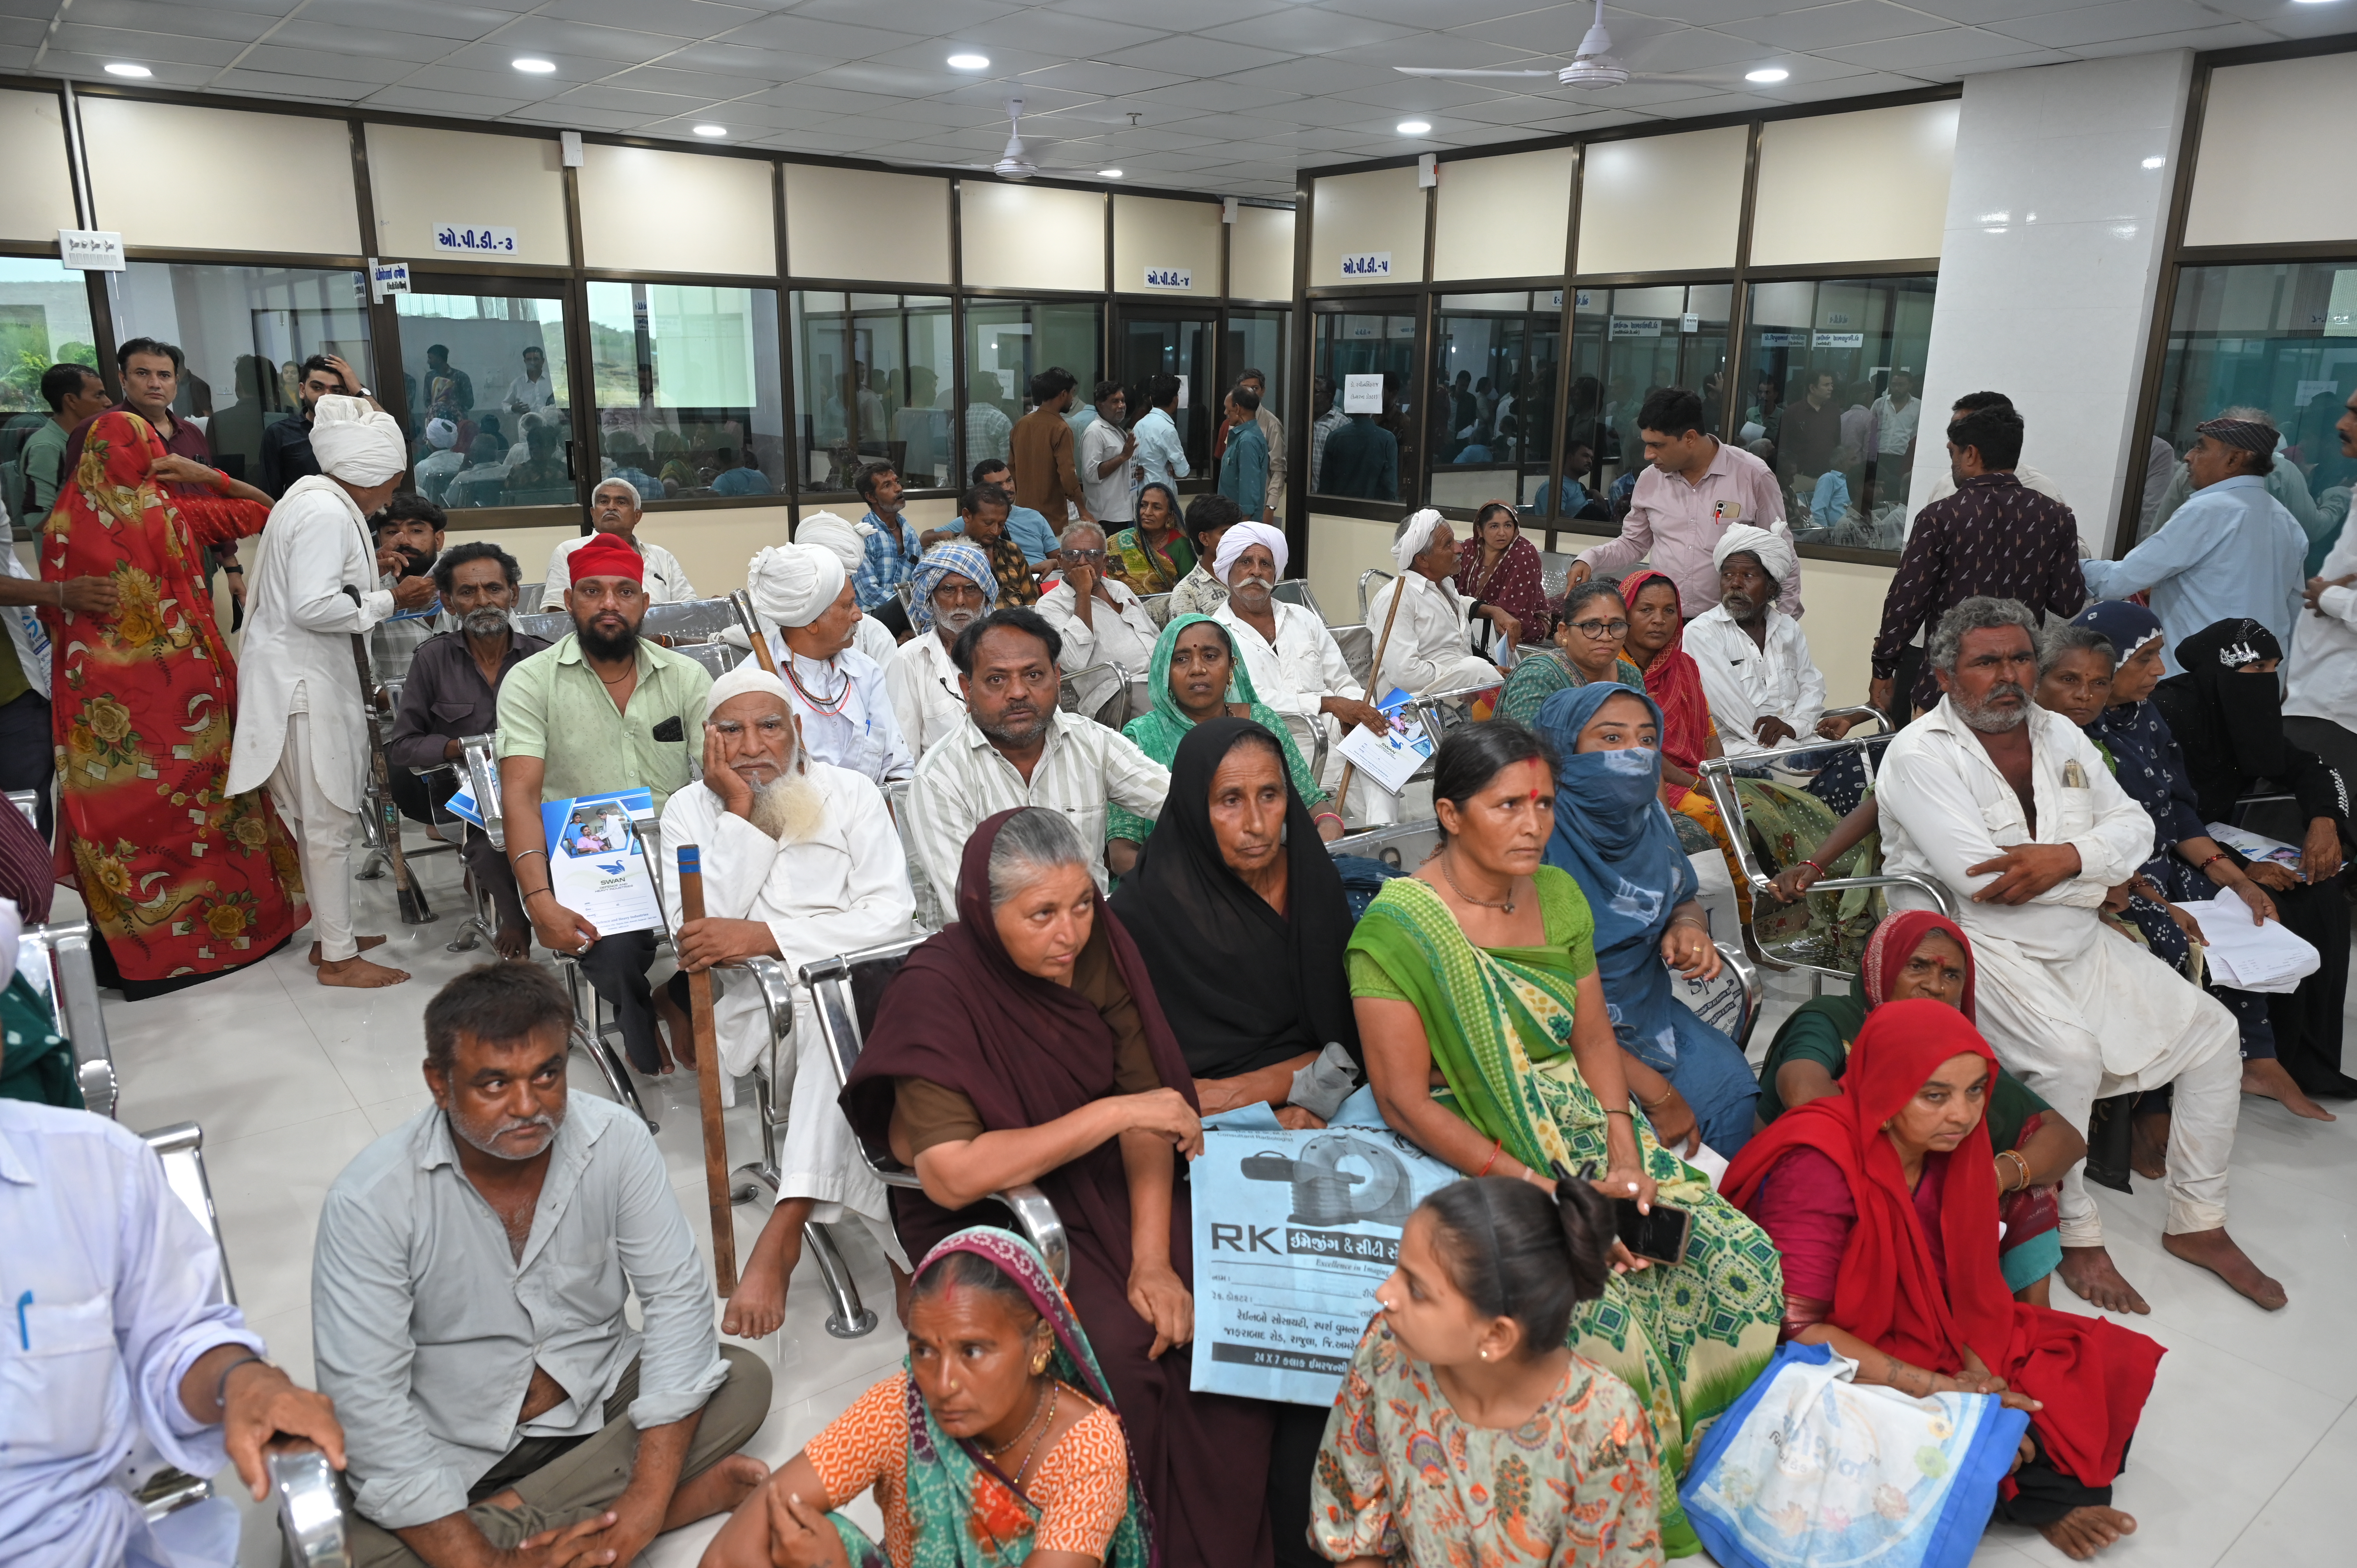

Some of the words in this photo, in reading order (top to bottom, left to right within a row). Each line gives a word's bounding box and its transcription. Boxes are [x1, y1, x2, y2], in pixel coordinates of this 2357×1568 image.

[1381, 743, 1396, 754] SWAN
[1211, 1223, 1283, 1255] RK
[1344, 1237, 1353, 1254] &
[1356, 1238, 1383, 1258] સીટી
[1316, 1258, 1352, 1270] Excellence
[1270, 1330, 1285, 1343] રોડ,
[1254, 1352, 1265, 1363] 24
[1275, 1354, 1280, 1364] 7
